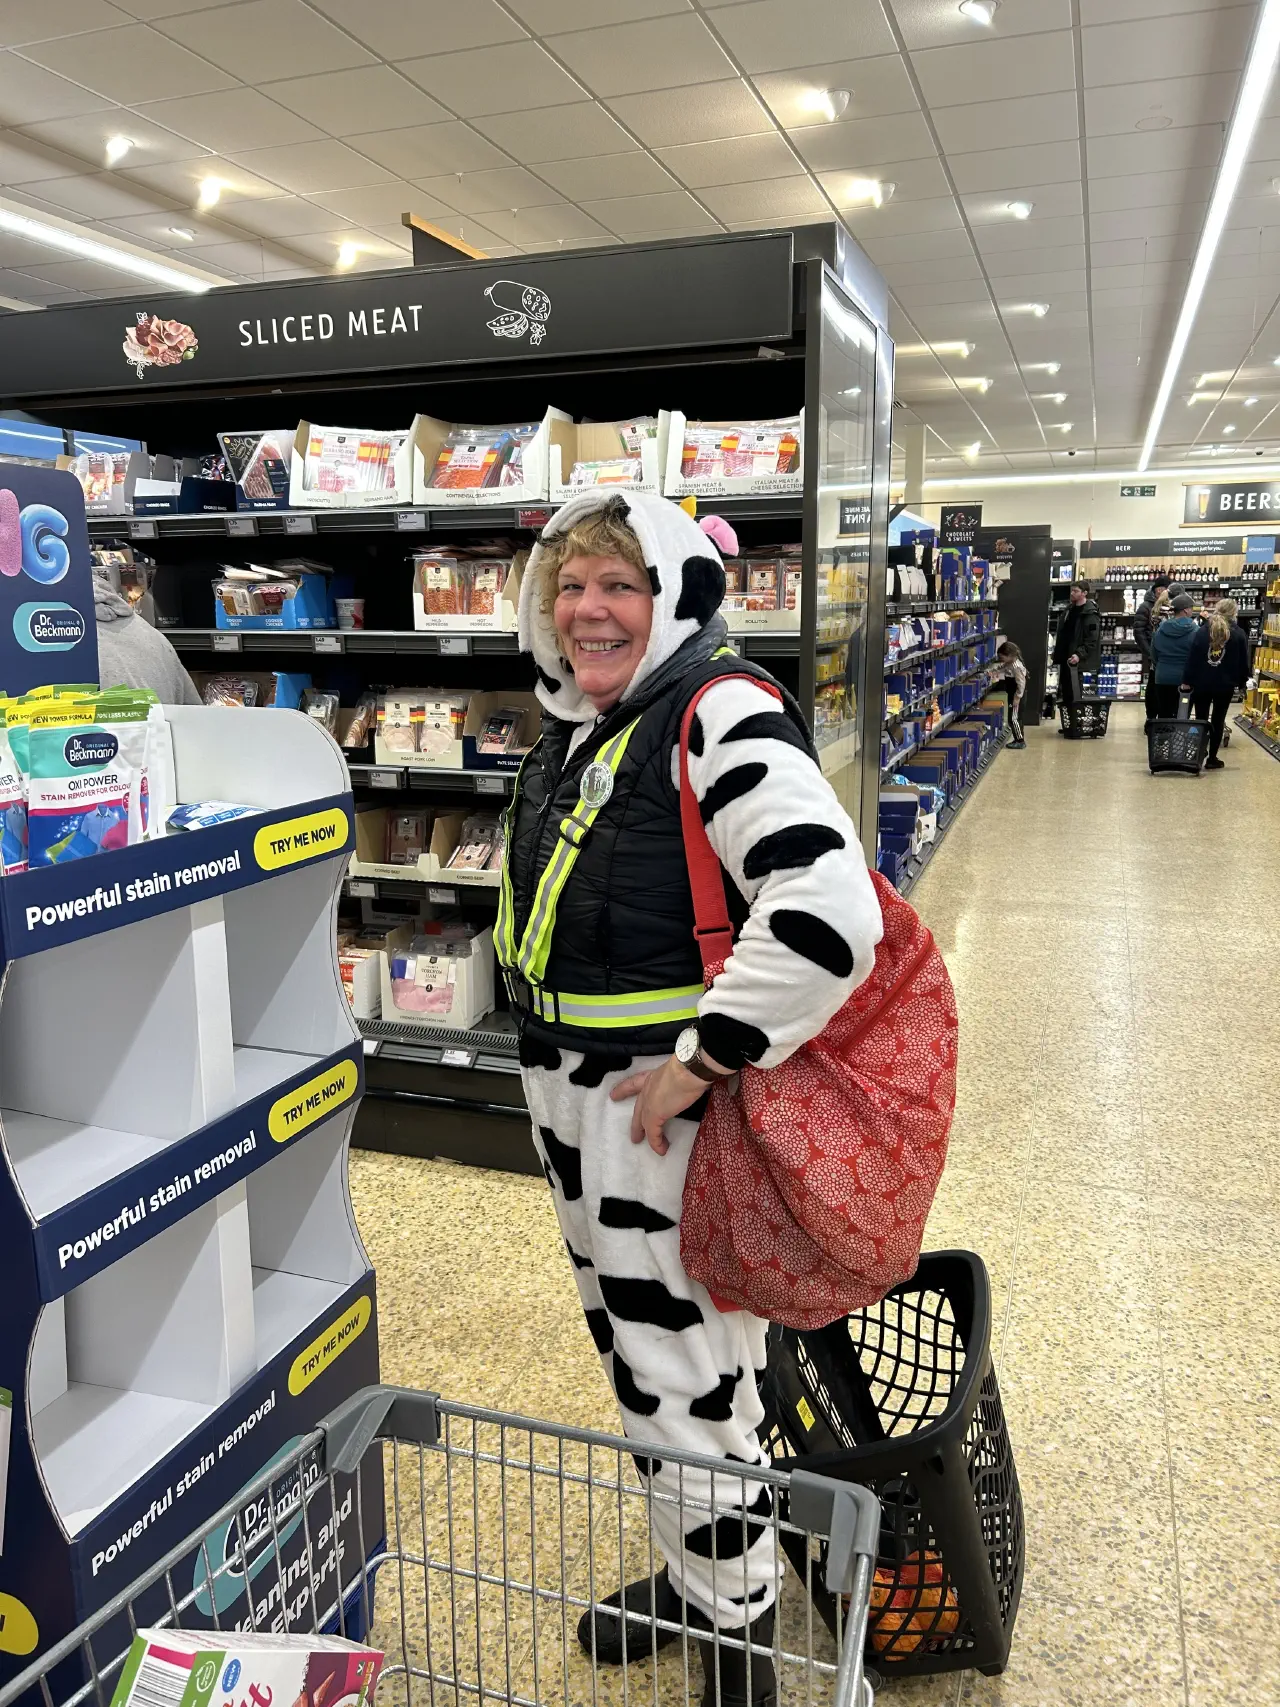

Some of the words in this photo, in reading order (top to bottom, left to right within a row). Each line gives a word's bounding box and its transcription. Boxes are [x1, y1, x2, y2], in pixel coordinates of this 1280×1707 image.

[238, 313, 334, 347] SLICED
[348, 304, 423, 337] MEAT
[1219, 491, 1280, 511] BEERS
[34, 624, 82, 638] Beckmann
[40, 614, 52, 626] Dr.
[69, 714, 93, 722] FORMULA
[69, 747, 114, 762] Beckmann
[74, 739, 83, 750] Dr.
[40, 793, 66, 801] STAIN
[68, 790, 95, 800] REMOVER
[96, 788, 108, 796] FOR
[109, 784, 131, 793] COLOU
[68, 779, 82, 791] OXI
[84, 775, 118, 788] POWER
[270, 837, 291, 855] TRY
[293, 832, 310, 850] ME
[312, 824, 336, 844] NOW
[26, 883, 122, 931] Powerful
[126, 872, 171, 902] stain
[174, 850, 241, 888] removal
[283, 1103, 304, 1125] TRY
[306, 1093, 321, 1112] ME
[322, 1075, 346, 1102] NOW
[58, 1197, 147, 1270] Powerful
[150, 1174, 192, 1213] stain
[194, 1129, 257, 1185] removal
[302, 1353, 321, 1377] TRY
[322, 1338, 337, 1356] ME
[337, 1312, 361, 1341] NOW
[91, 1483, 173, 1577] Powerful
[176, 1450, 215, 1499] stain
[218, 1389, 277, 1459] removal
[276, 1461, 309, 1499] ORIGINL
[244, 1496, 268, 1532] Dr.
[317, 1488, 352, 1551] and
[226, 1664, 237, 1688] NEW
